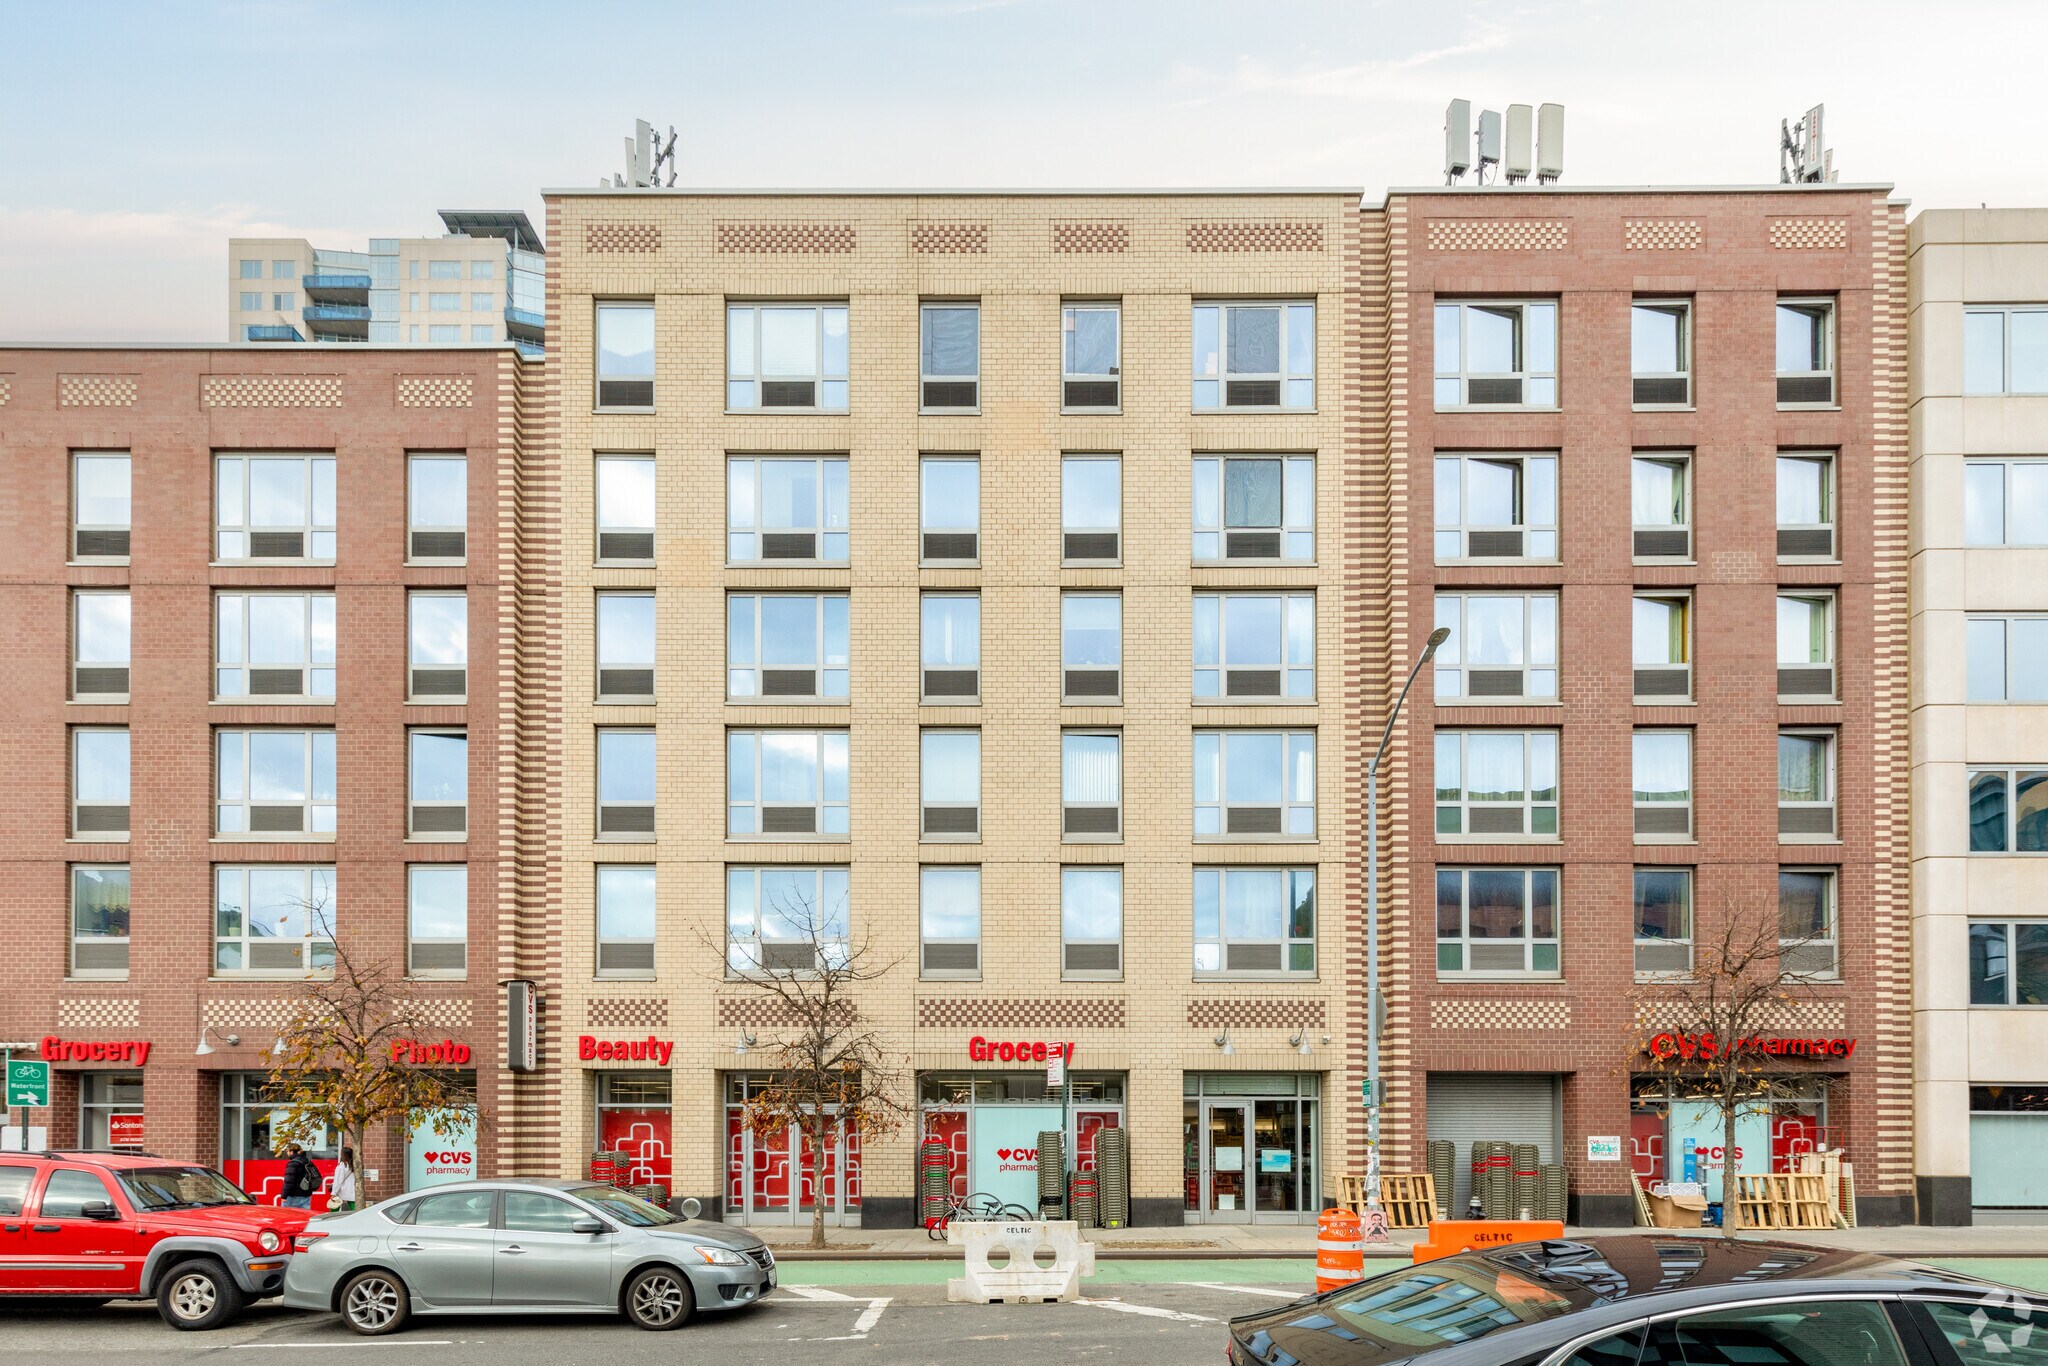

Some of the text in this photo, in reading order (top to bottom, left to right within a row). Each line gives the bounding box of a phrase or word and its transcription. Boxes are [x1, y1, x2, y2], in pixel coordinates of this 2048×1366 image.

[41, 1035, 151, 1066] Grocery
[391, 1038, 471, 1065] Photo
[578, 1035, 674, 1066] Beauty
[969, 1036, 1075, 1067] Grocey
[10, 1082, 46, 1090] Waterfront
[439, 1151, 472, 1164] CVS
[1710, 1146, 1744, 1160] CS
[426, 1165, 470, 1176] pharmacy
[999, 1162, 1038, 1173] pharmac
[1474, 1233, 1513, 1241] CELTIC
